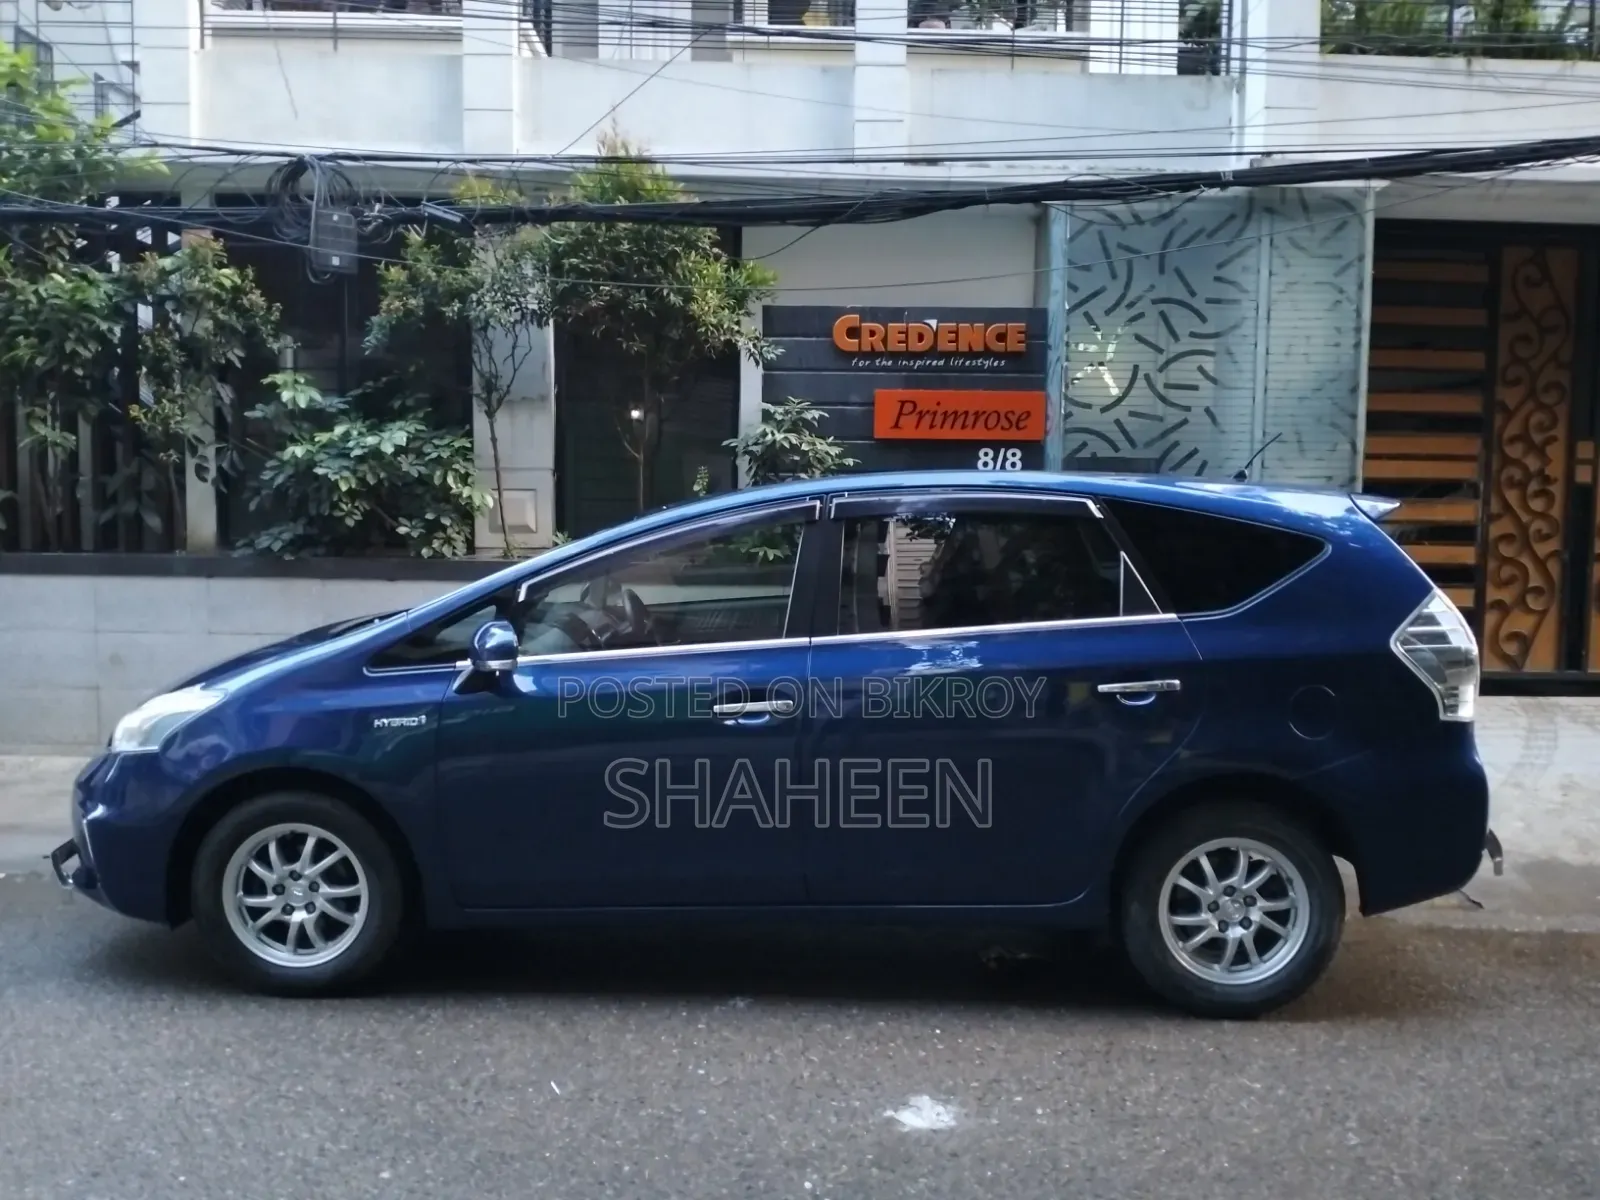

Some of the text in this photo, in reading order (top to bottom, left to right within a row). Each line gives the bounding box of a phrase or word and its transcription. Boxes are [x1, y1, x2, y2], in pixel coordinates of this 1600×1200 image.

[832, 314, 1026, 352] CREDENCE
[851, 357, 1006, 370] for the inspired lifestyles
[890, 399, 1032, 431] Primrose
[977, 447, 1022, 471] 8/8
[373, 716, 419, 728] HYBRID
